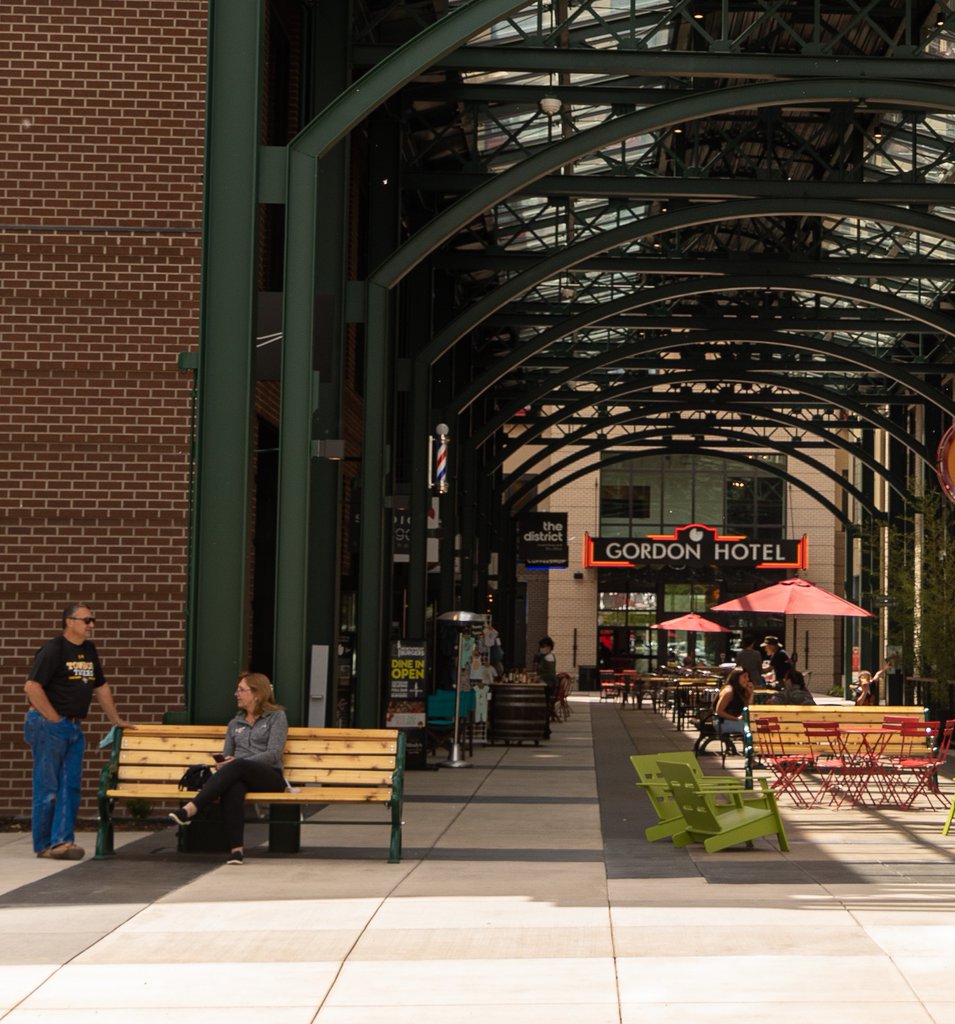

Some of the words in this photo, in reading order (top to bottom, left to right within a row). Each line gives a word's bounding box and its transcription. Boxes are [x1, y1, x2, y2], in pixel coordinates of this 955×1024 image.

[543, 521, 563, 531] the
[523, 531, 563, 542] district
[605, 542, 701, 560] GORDON
[714, 543, 786, 561] HOTEL
[391, 659, 414, 668] DINE
[415, 659, 425, 668] IN
[391, 668, 425, 680] OPEN
